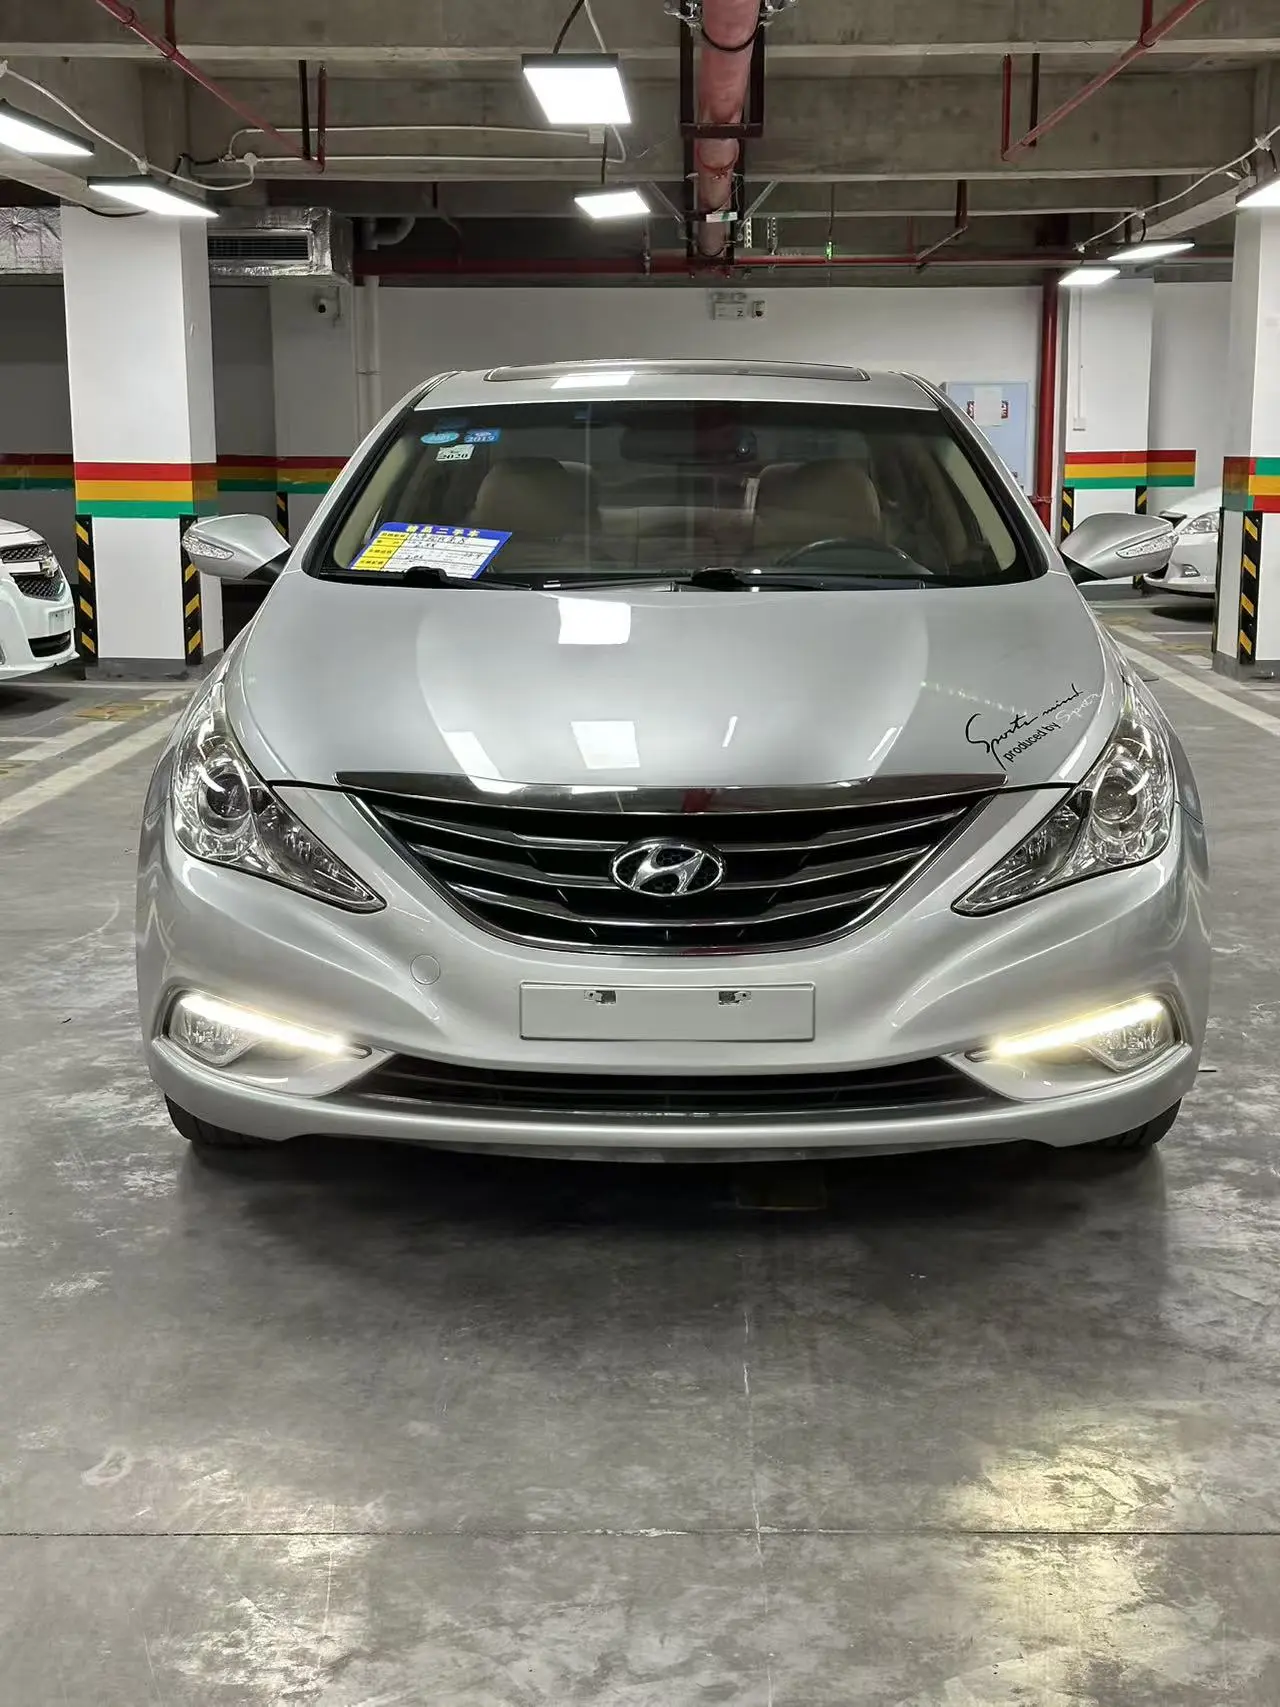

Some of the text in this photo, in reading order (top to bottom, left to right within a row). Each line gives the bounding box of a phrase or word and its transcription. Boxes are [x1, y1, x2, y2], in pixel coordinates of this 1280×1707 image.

[437, 452, 469, 460] 2020
[1003, 728, 1046, 762] produced
[1043, 722, 1061, 734] by
